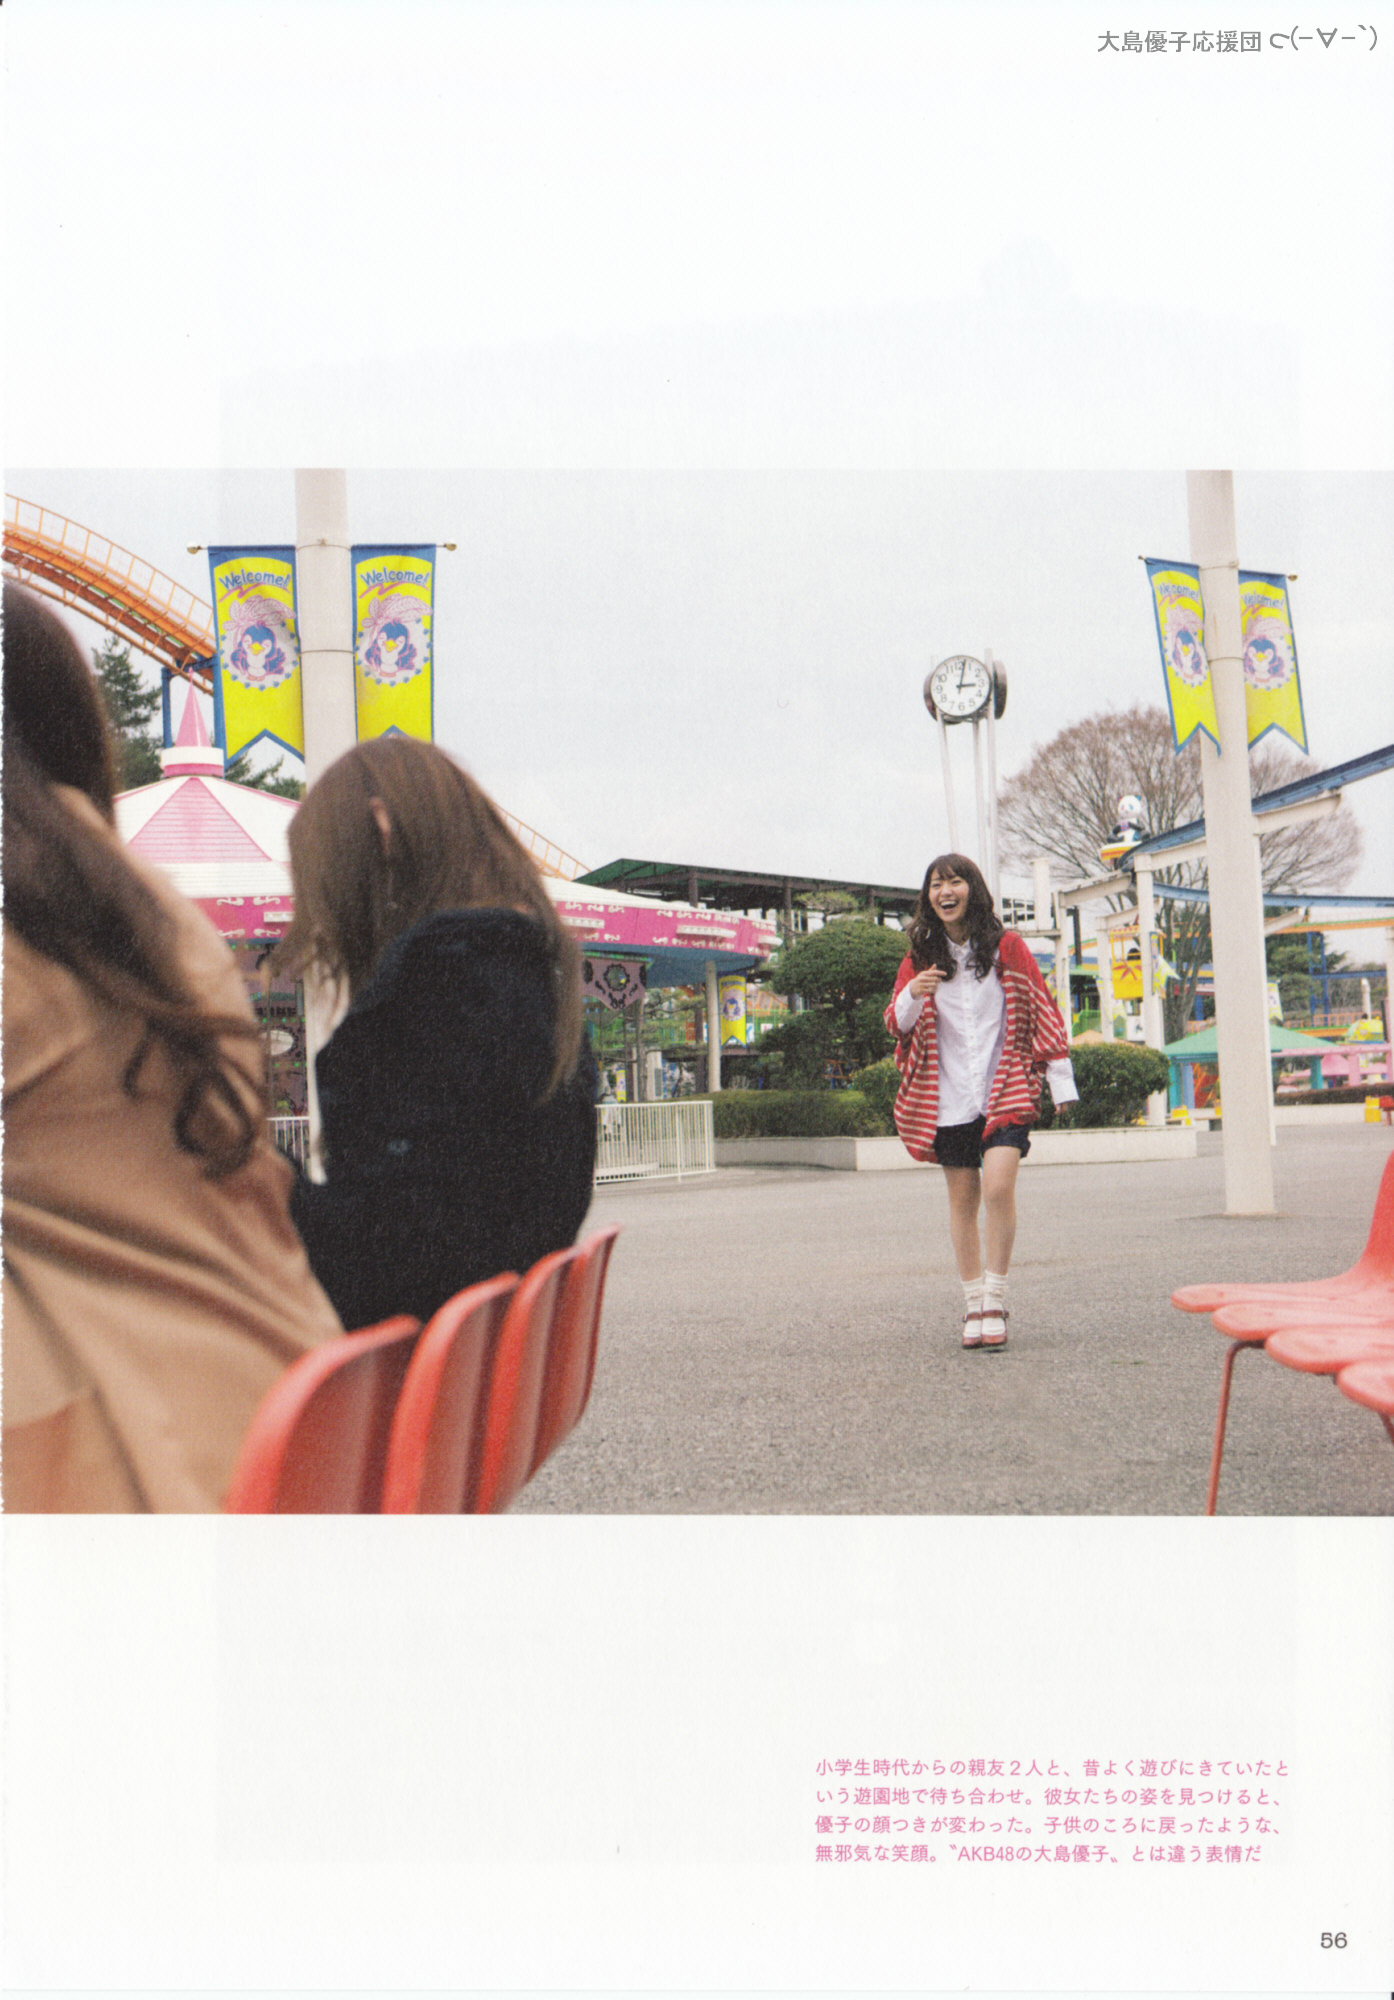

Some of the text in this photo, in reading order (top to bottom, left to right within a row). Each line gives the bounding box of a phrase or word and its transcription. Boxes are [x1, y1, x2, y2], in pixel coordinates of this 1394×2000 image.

[218, 568, 290, 588] Welcome!
[361, 567, 430, 587] Welcome!
[815, 1758, 1290, 1778] 小学生時代からの親友２人と、昔よく遊びにきていたと
[815, 1787, 1282, 1806] いう遊園地で待ち合わせ。彼女たちの姿を見つけると、
[815, 1815, 1281, 1835] 優子の顔つきが変わった。子供のころに戻ったような、
[1320, 1931, 1348, 1949] 56
